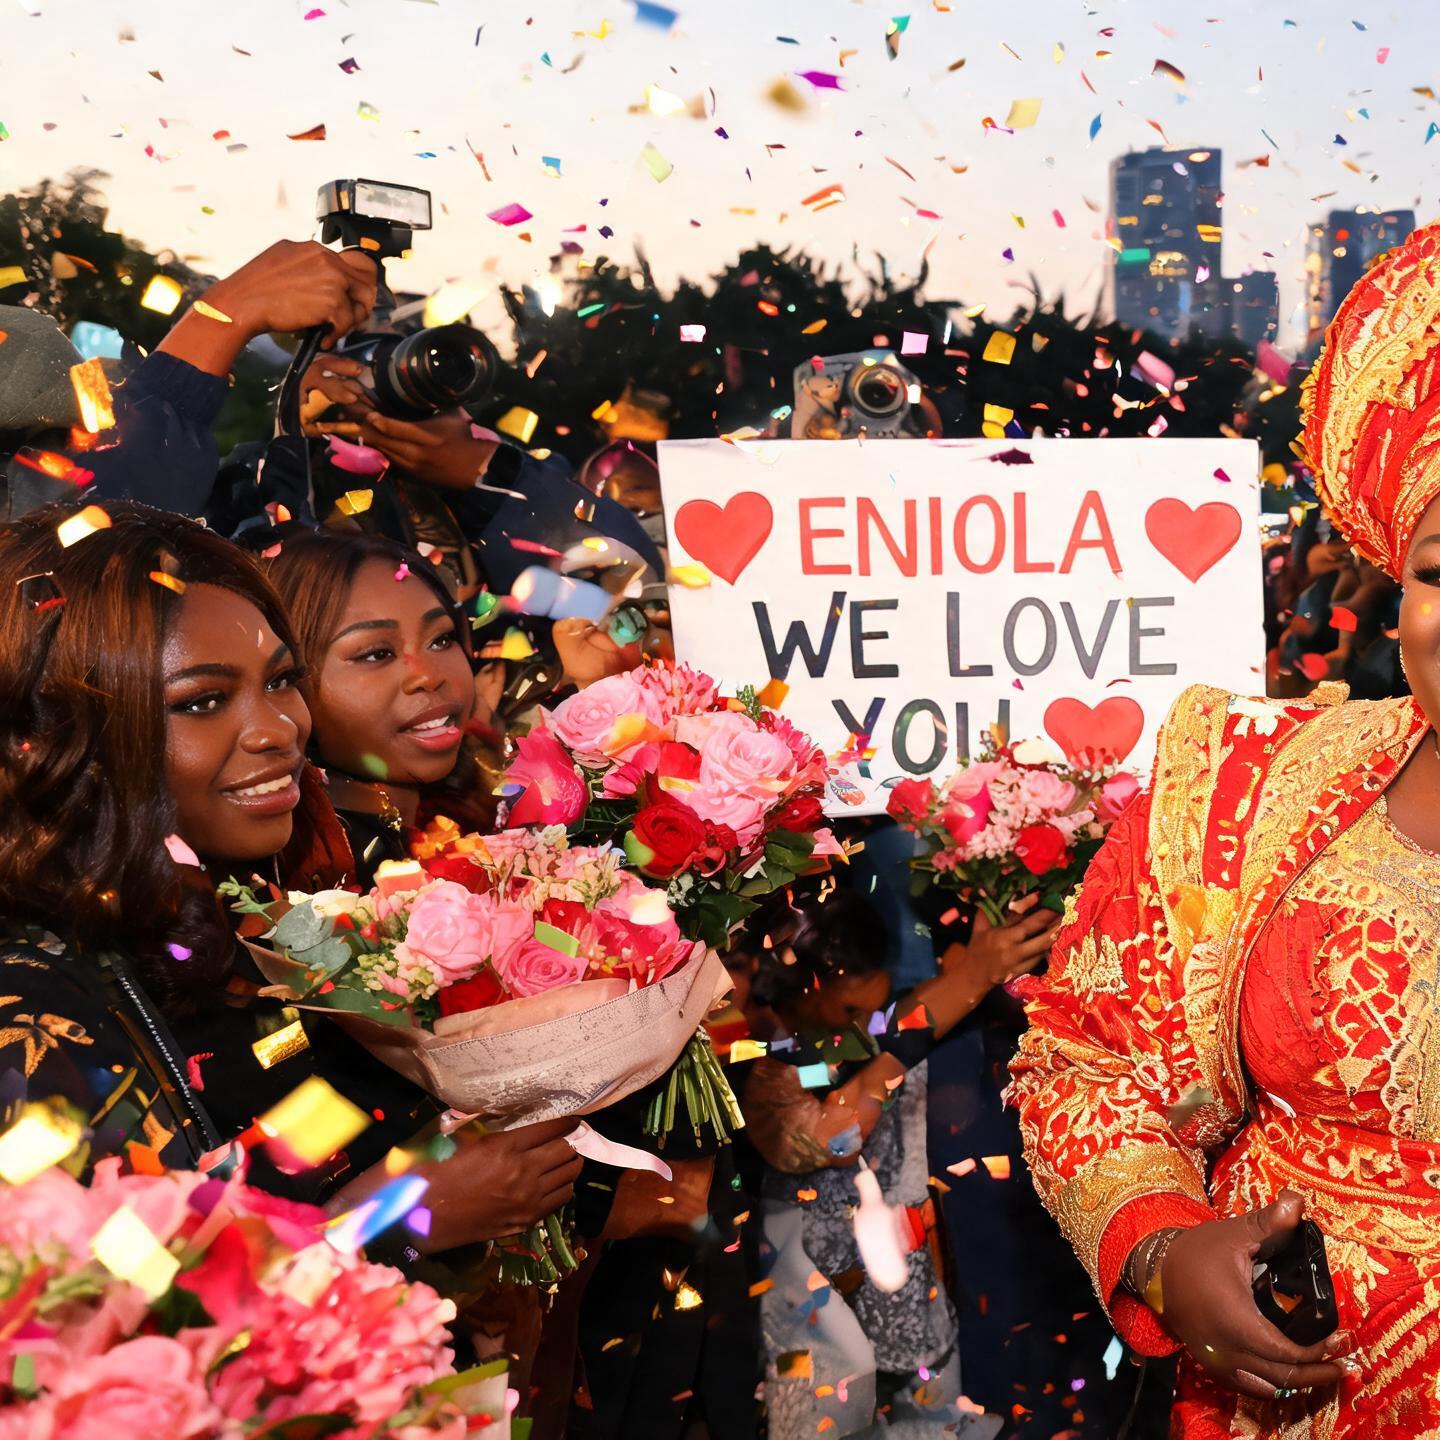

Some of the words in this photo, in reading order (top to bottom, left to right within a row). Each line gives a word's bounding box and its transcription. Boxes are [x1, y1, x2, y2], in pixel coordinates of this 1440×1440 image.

[799, 490, 1123, 578] ENIOLA
[752, 591, 900, 679] WE
[946, 591, 1178, 680] LOVE
[831, 697, 1011, 778] YOU
